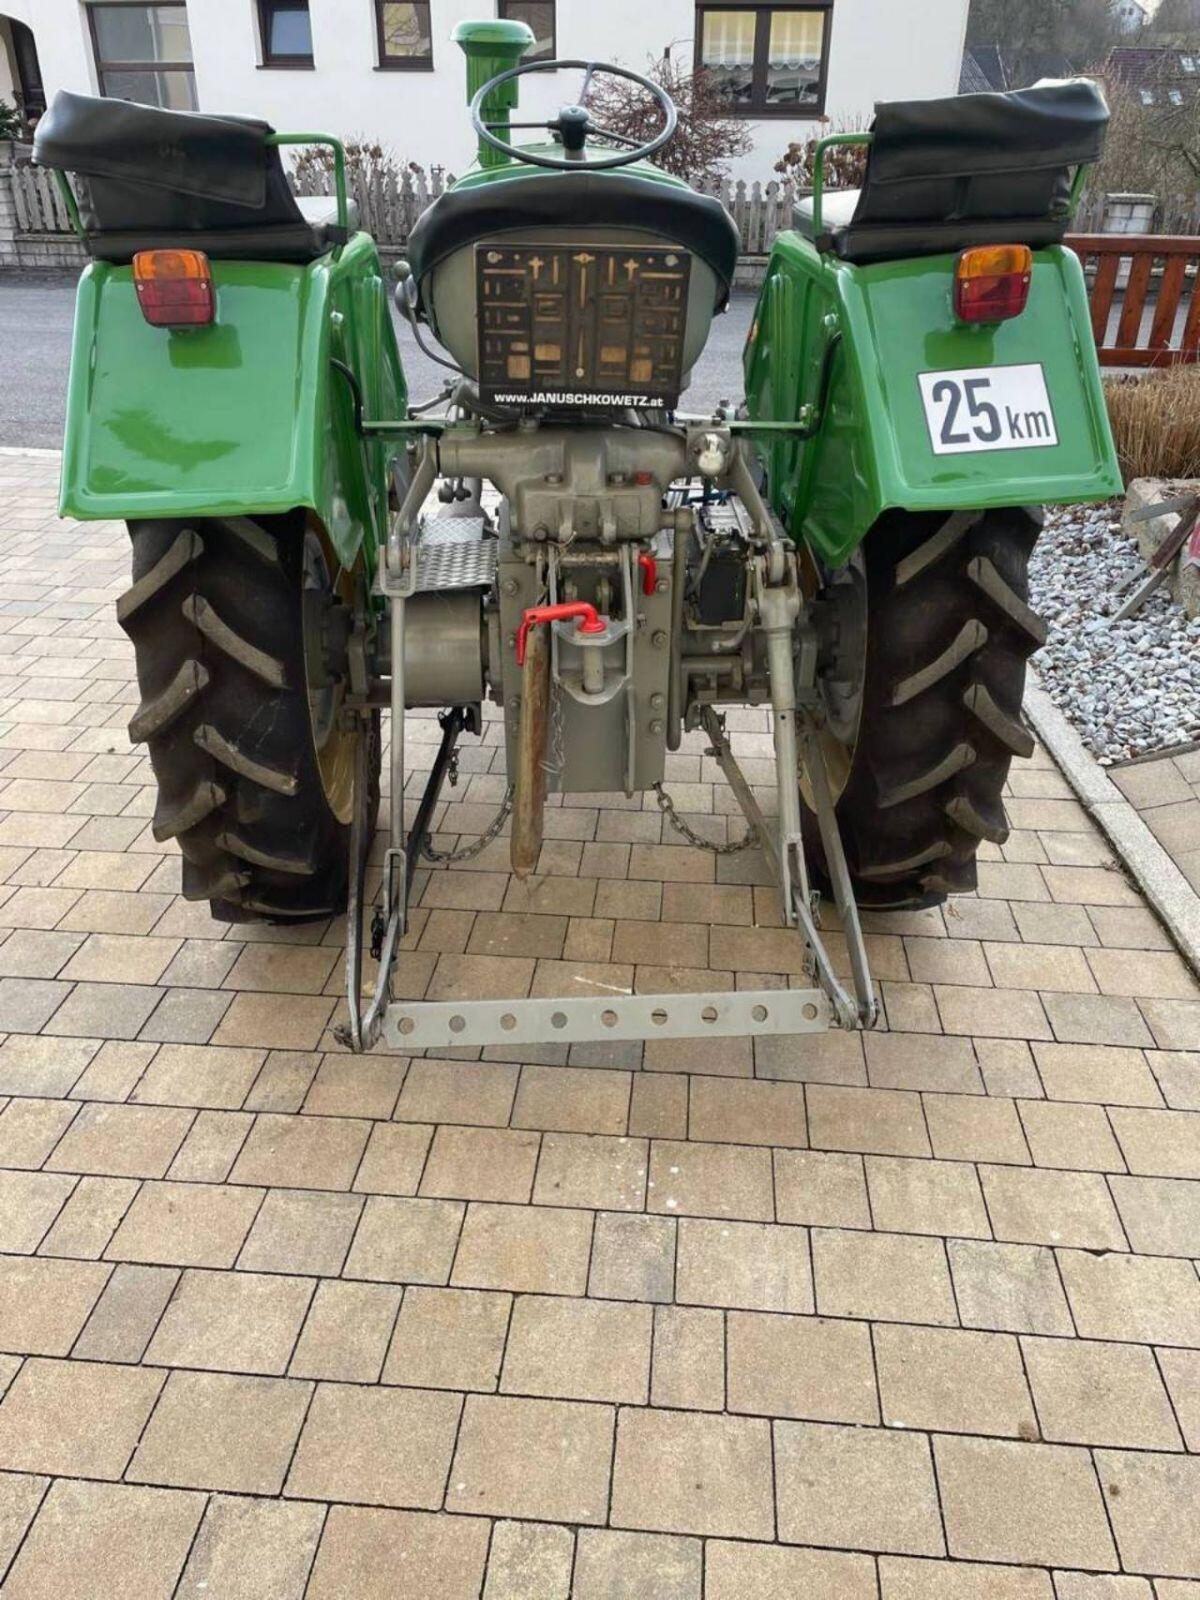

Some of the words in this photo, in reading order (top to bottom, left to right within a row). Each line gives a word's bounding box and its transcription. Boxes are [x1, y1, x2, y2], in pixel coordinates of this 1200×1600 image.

[494, 392, 664, 407] www.JANUSCHKOWETZ.at
[932, 378, 1002, 443] 25
[1005, 406, 1050, 439] km
